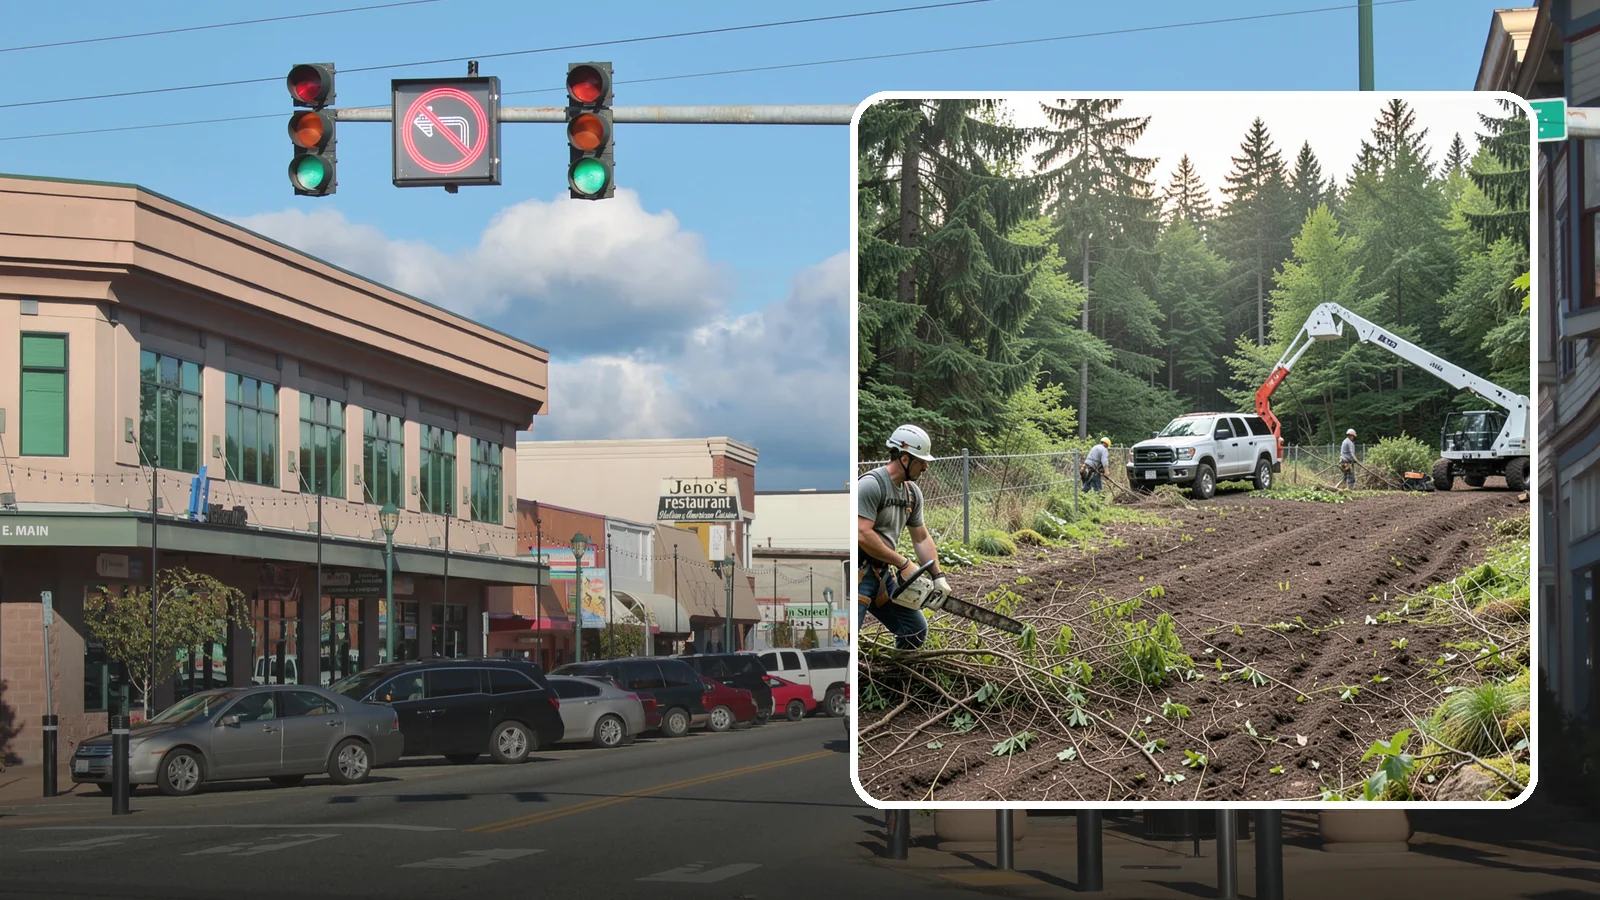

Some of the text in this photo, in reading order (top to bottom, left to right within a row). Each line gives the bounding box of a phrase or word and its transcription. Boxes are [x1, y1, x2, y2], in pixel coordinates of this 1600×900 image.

[670, 480, 727, 494] Jeno's
[664, 496, 731, 509] restaurant
[659, 509, 681, 519] Italian
[686, 509, 714, 519] American
[715, 509, 738, 519] Cuisine
[2, 525, 49, 536] E. MAIN
[797, 608, 828, 617] Street
